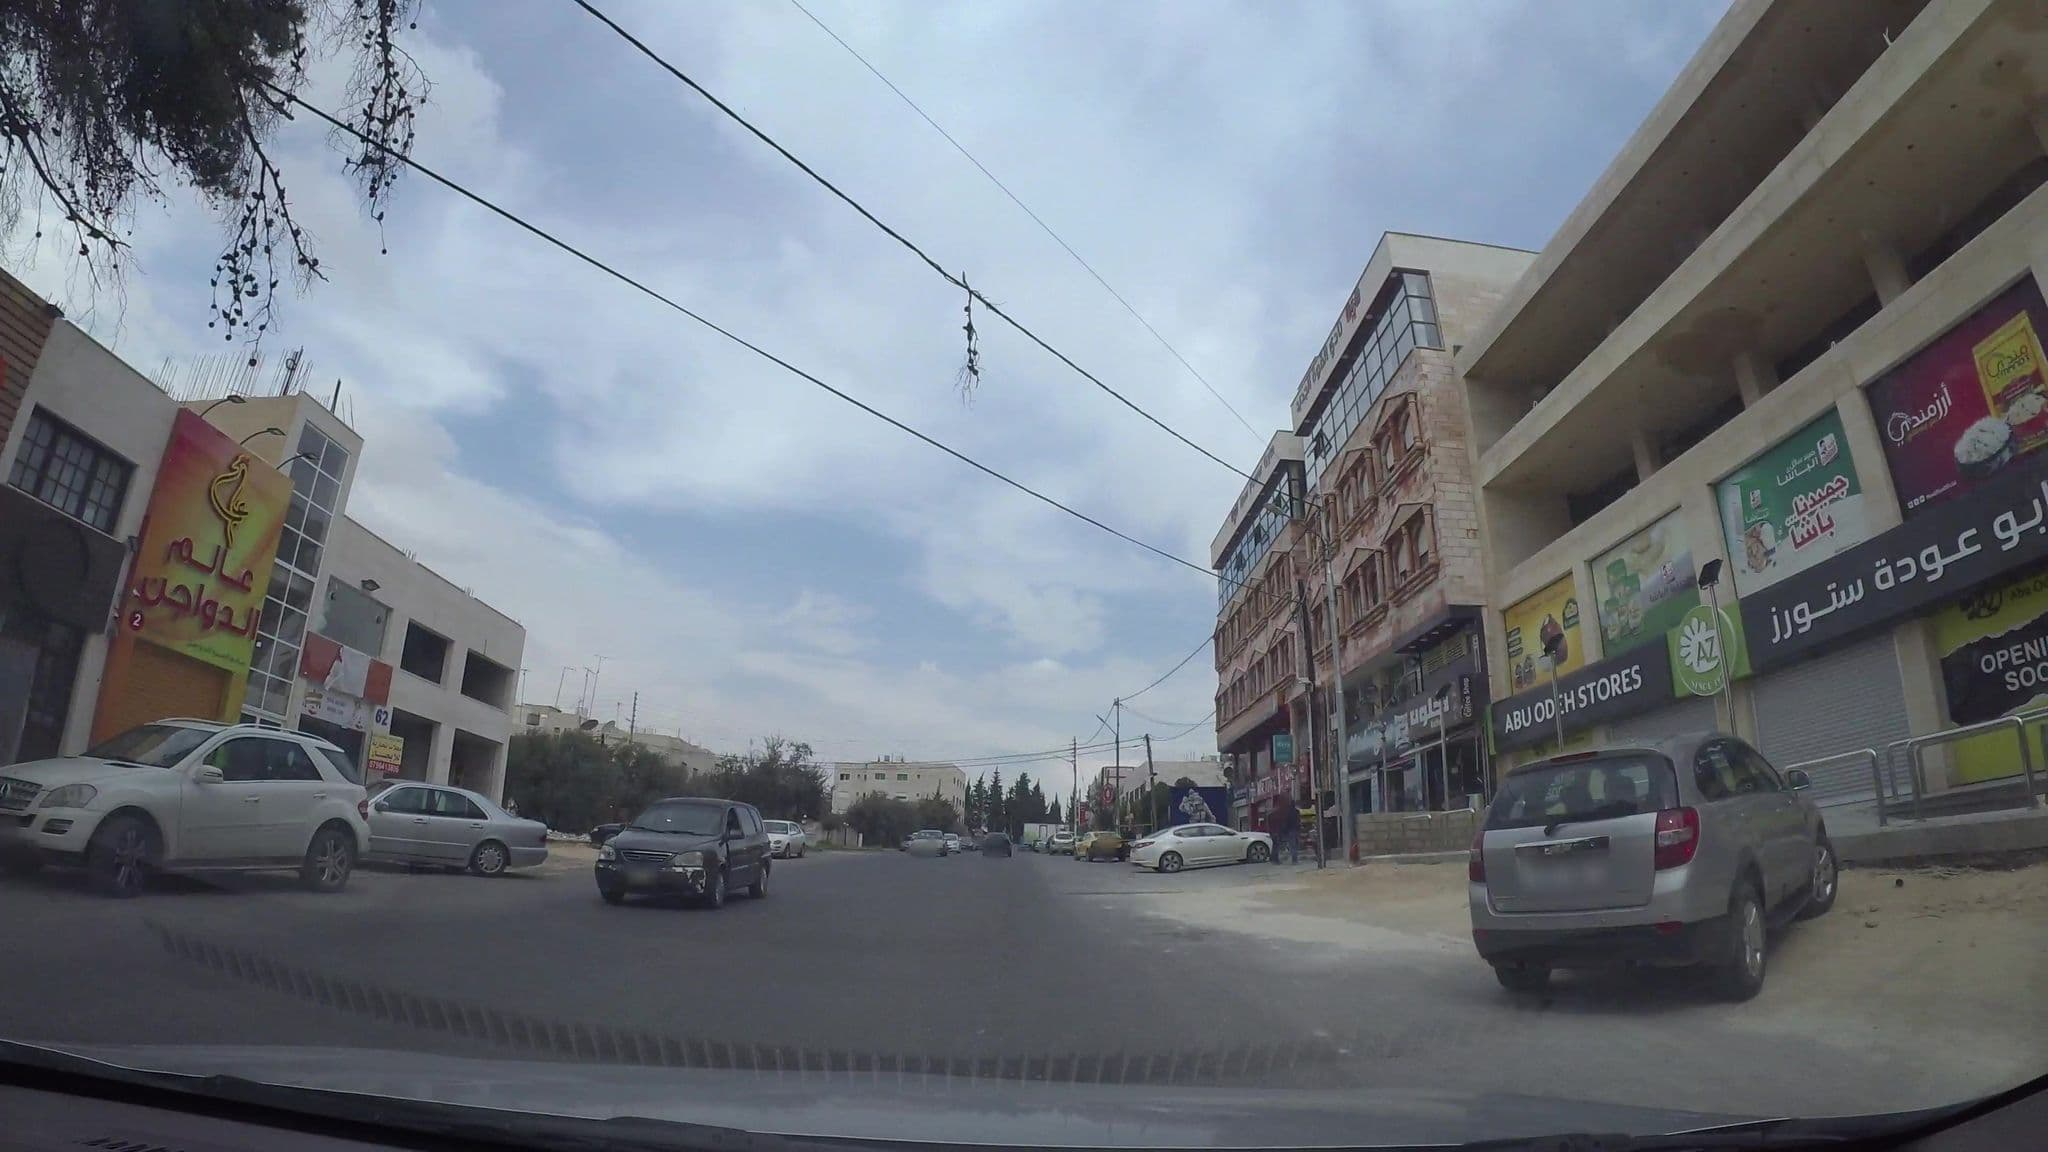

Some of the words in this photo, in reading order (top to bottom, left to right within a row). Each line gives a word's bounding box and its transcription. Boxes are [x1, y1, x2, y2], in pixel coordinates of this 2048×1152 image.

[1789, 512, 1835, 550] باشا
[166, 537, 254, 592] عالم
[1874, 528, 1982, 591] عودة
[133, 612, 141, 628] 2
[140, 576, 261, 640] الدواجن
[1770, 578, 1864, 644] ستورز
[1980, 636, 2048, 674] OPENI
[375, 708, 389, 726] 62
[1505, 706, 1532, 734] ABU
[1578, 664, 1642, 708] STORES
